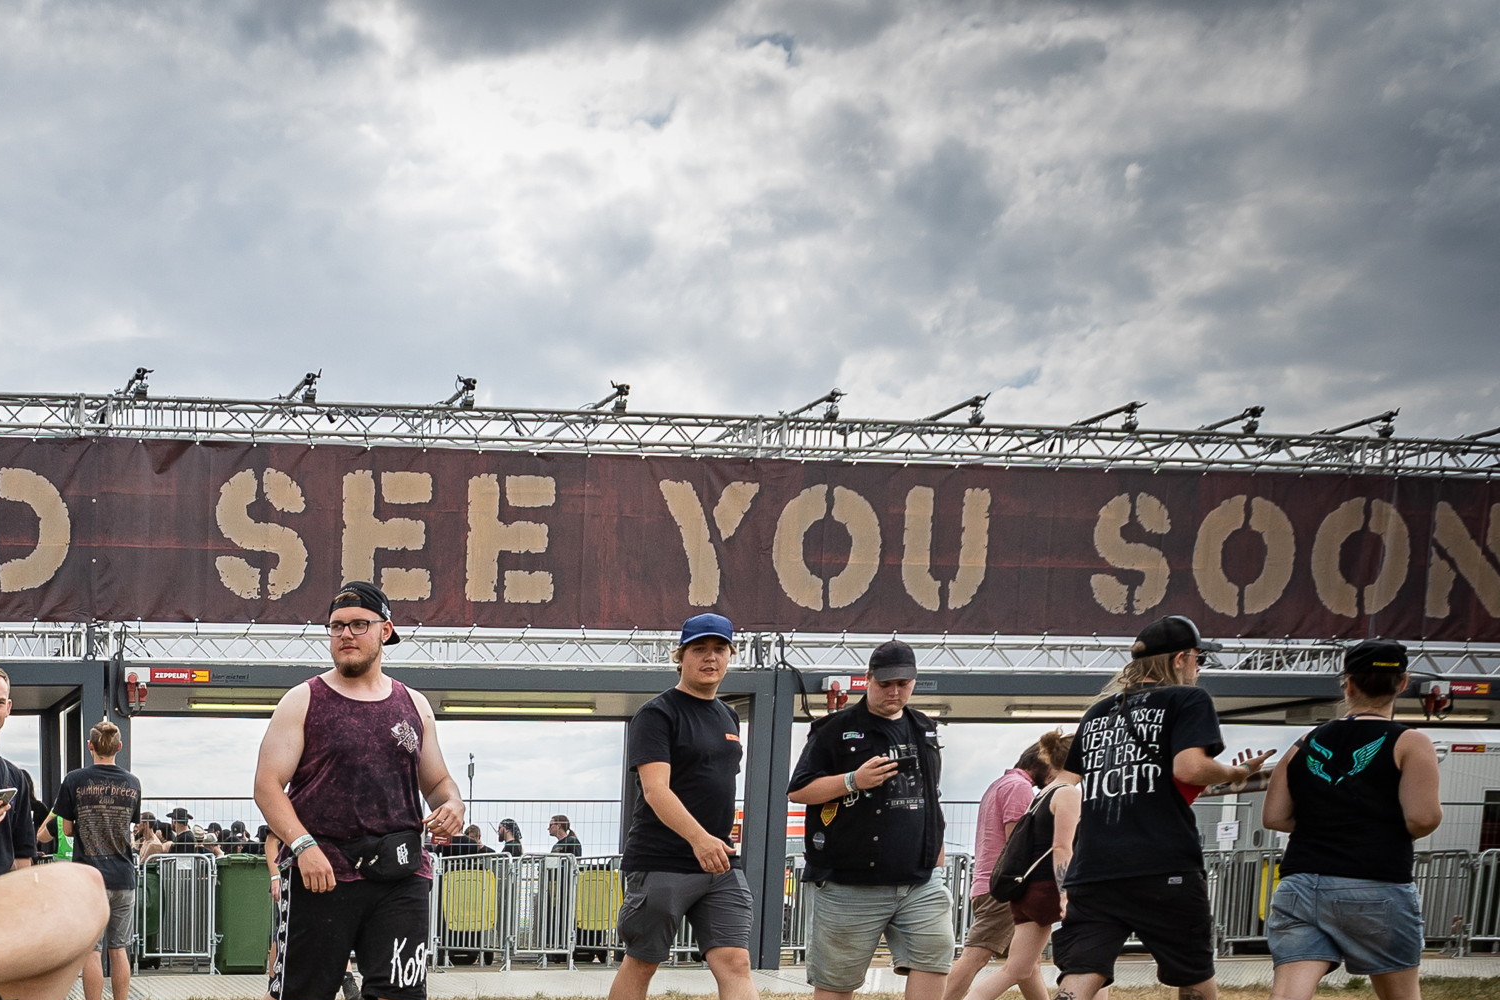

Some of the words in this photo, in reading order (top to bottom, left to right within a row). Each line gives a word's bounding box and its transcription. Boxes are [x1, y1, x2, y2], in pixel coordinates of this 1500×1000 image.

[215, 467, 556, 600] SEE
[659, 478, 992, 612] YOU
[1090, 491, 1500, 618] SOON
[1082, 716, 1109, 736] DER
[1114, 708, 1166, 728] MNSCH
[1082, 763, 1162, 802] NICHT
